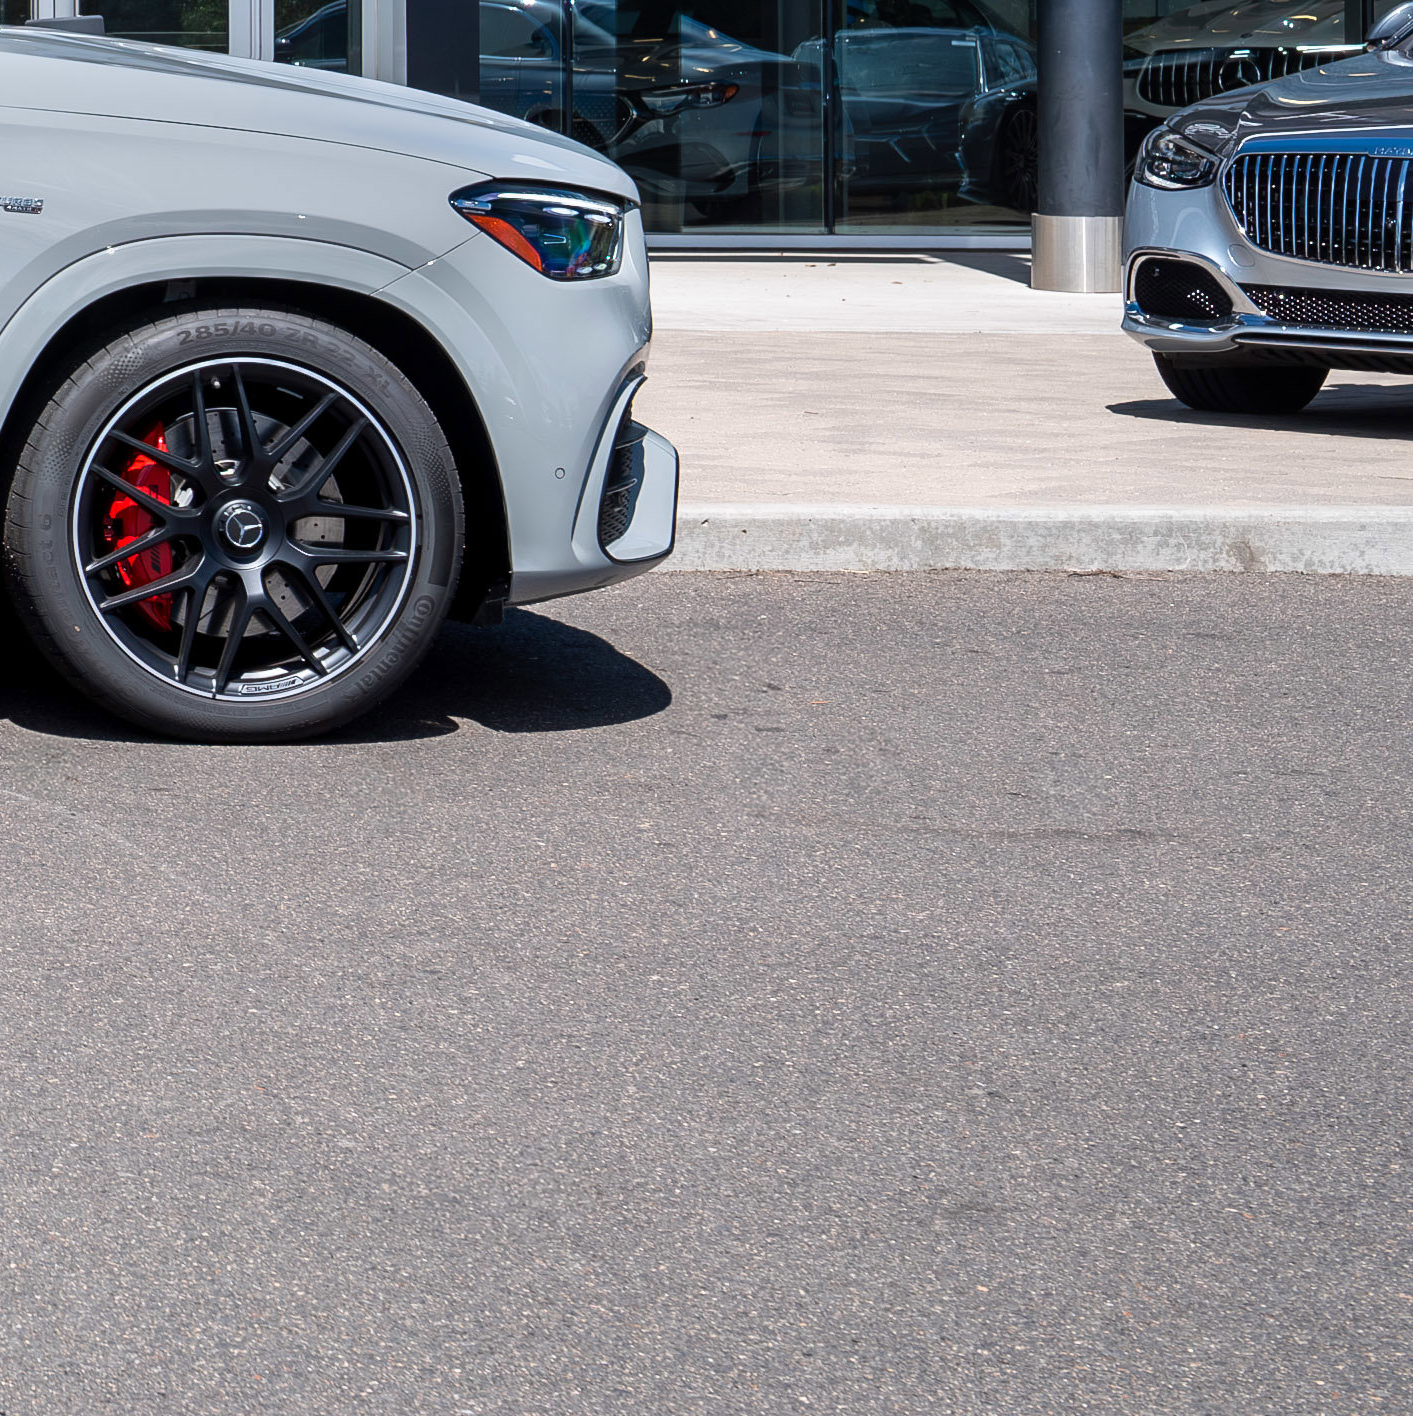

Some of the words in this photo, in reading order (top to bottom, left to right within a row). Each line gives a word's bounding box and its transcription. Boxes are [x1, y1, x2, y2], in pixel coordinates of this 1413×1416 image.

[175, 321, 277, 347] 285/40
[283, 326, 323, 351] ZR
[321, 339, 358, 368] 22
[351, 591, 437, 697] Continental
